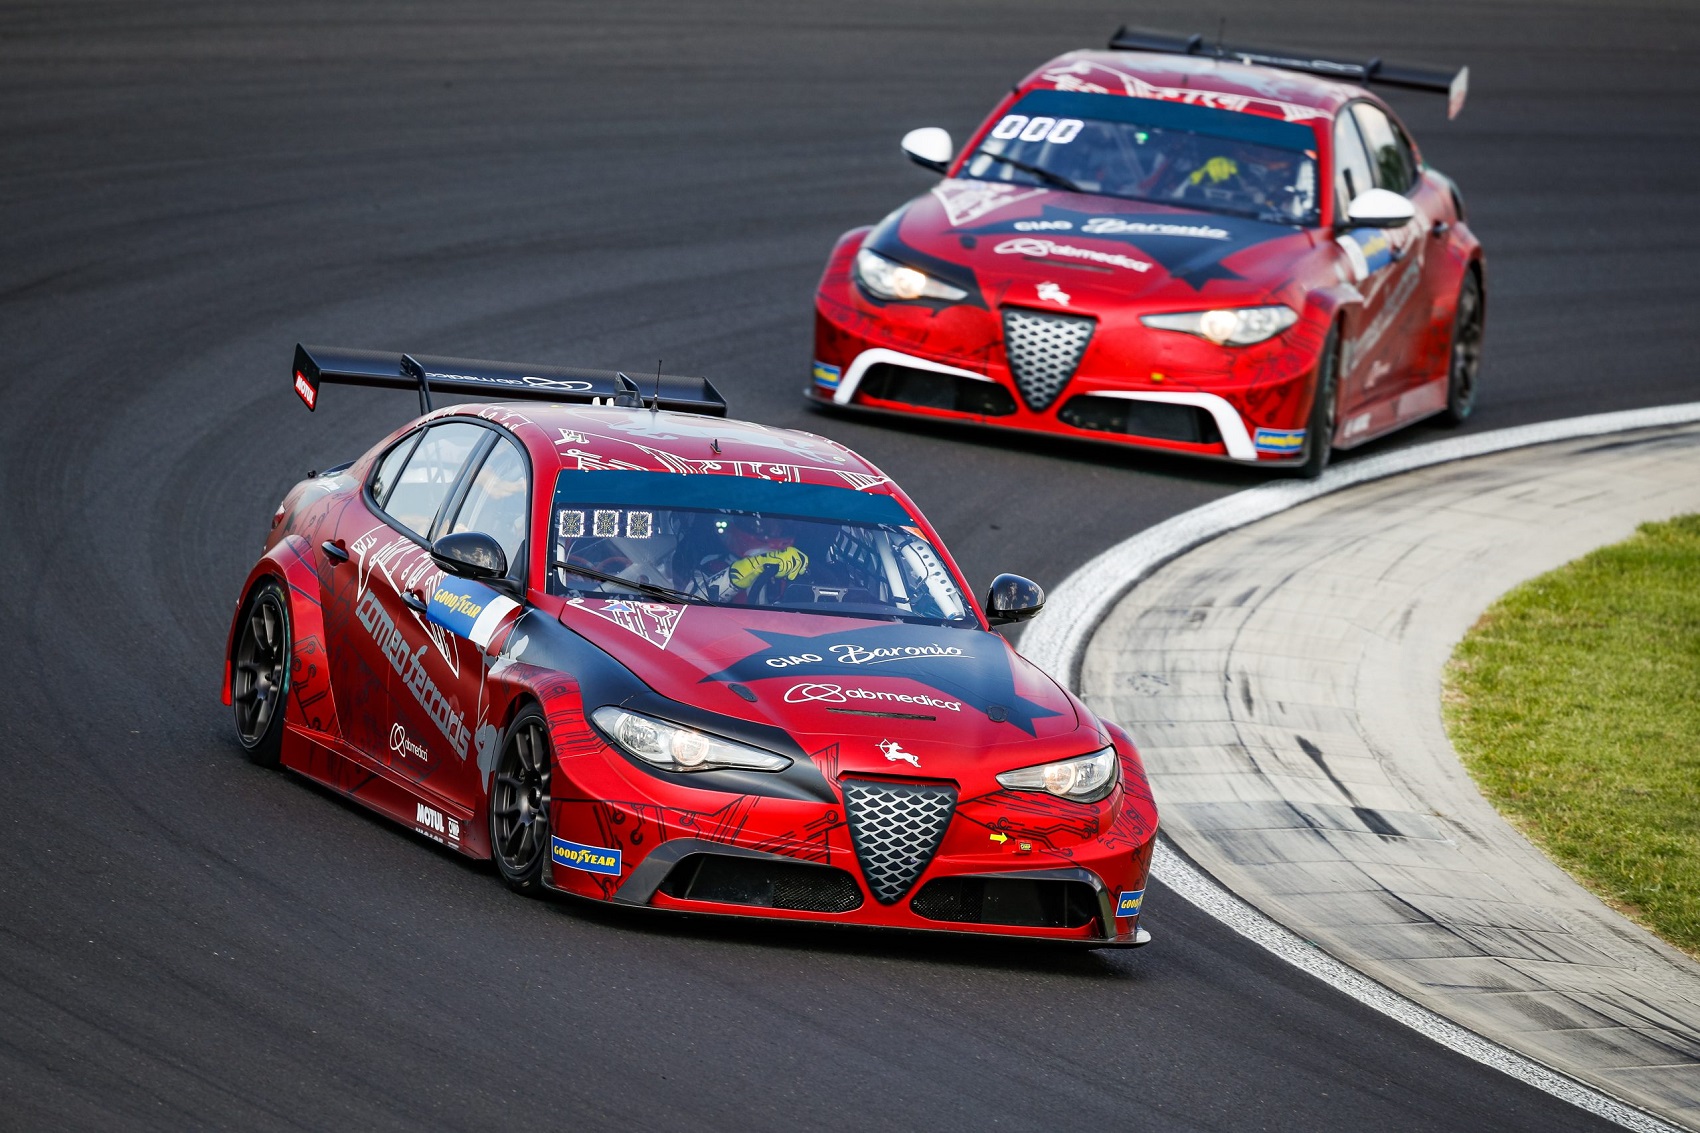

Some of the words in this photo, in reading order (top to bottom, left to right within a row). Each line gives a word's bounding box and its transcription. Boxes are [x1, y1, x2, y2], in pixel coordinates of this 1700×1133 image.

[992, 115, 1084, 144] 000
[295, 375, 314, 405] MOTUL
[433, 588, 482, 619] GOODYEAR
[765, 653, 823, 668] CIAO
[828, 643, 976, 665] Baronio
[416, 802, 445, 833] MOTUL
[553, 845, 616, 867] GOODYEAR
